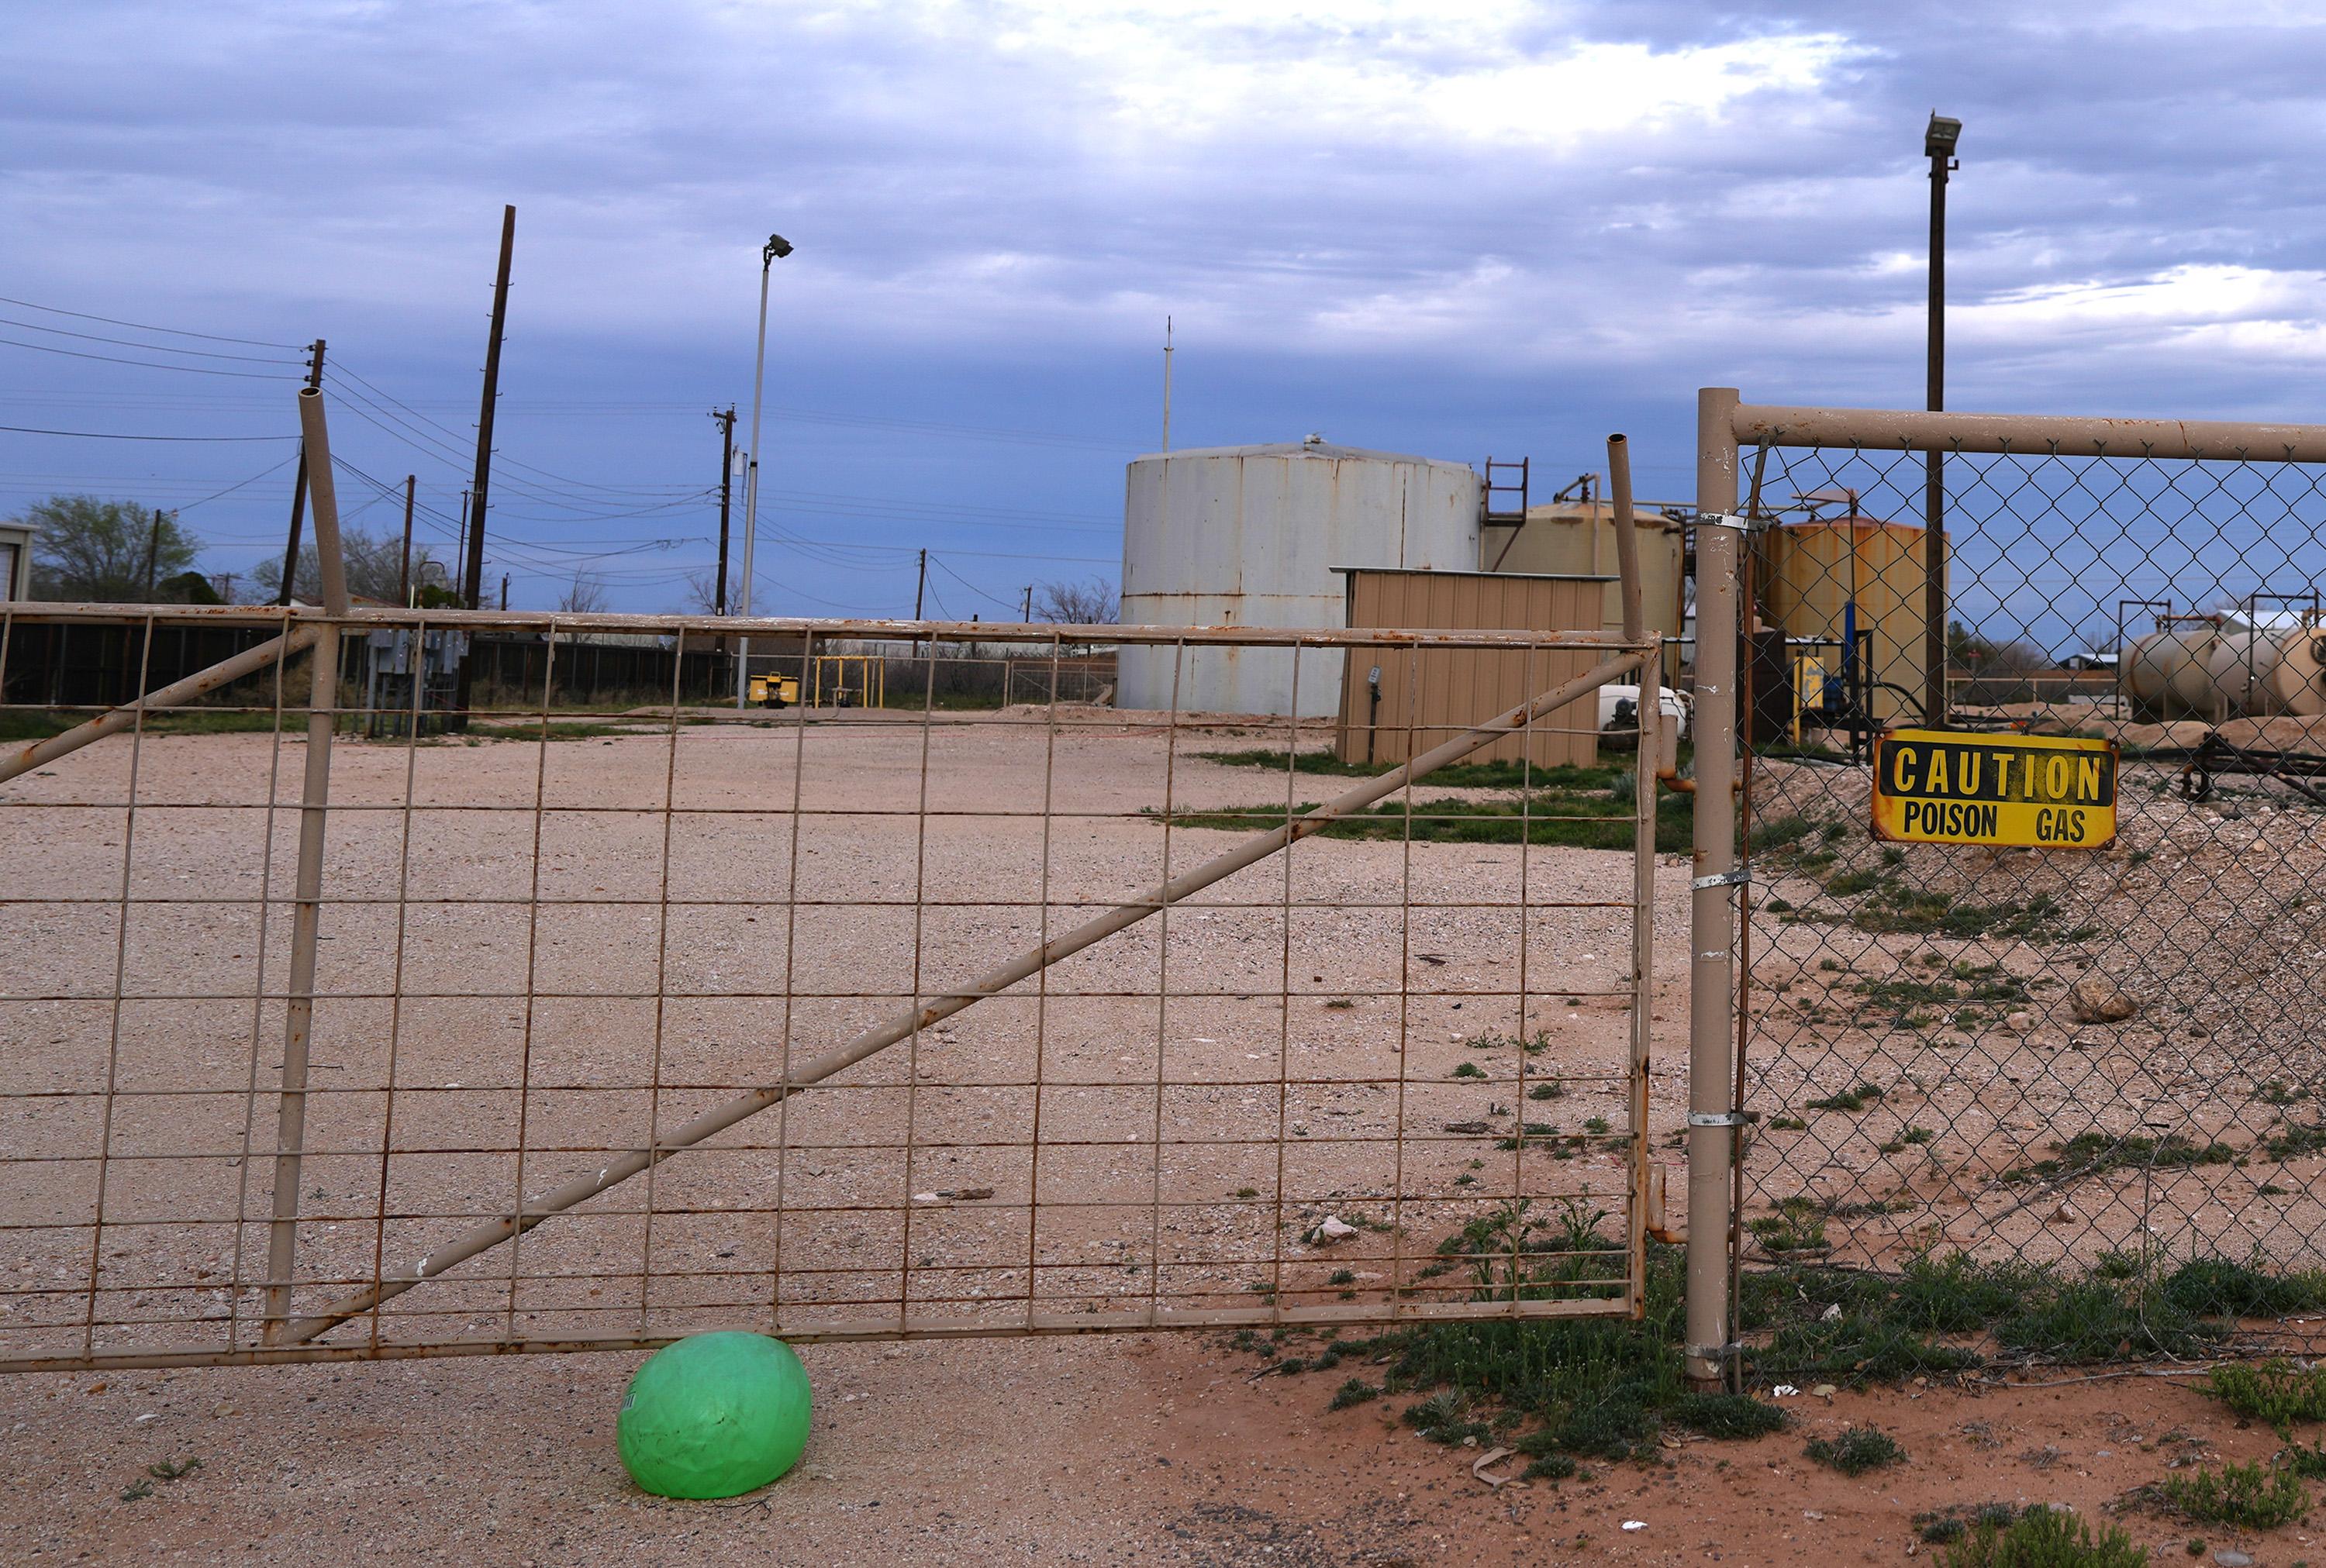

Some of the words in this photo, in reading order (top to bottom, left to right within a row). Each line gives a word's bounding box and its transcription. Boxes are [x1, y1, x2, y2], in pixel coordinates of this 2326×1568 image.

[1893, 747, 2100, 801] CAUTION
[1903, 801, 1998, 837] POISON
[2036, 808, 2086, 843] GAS
